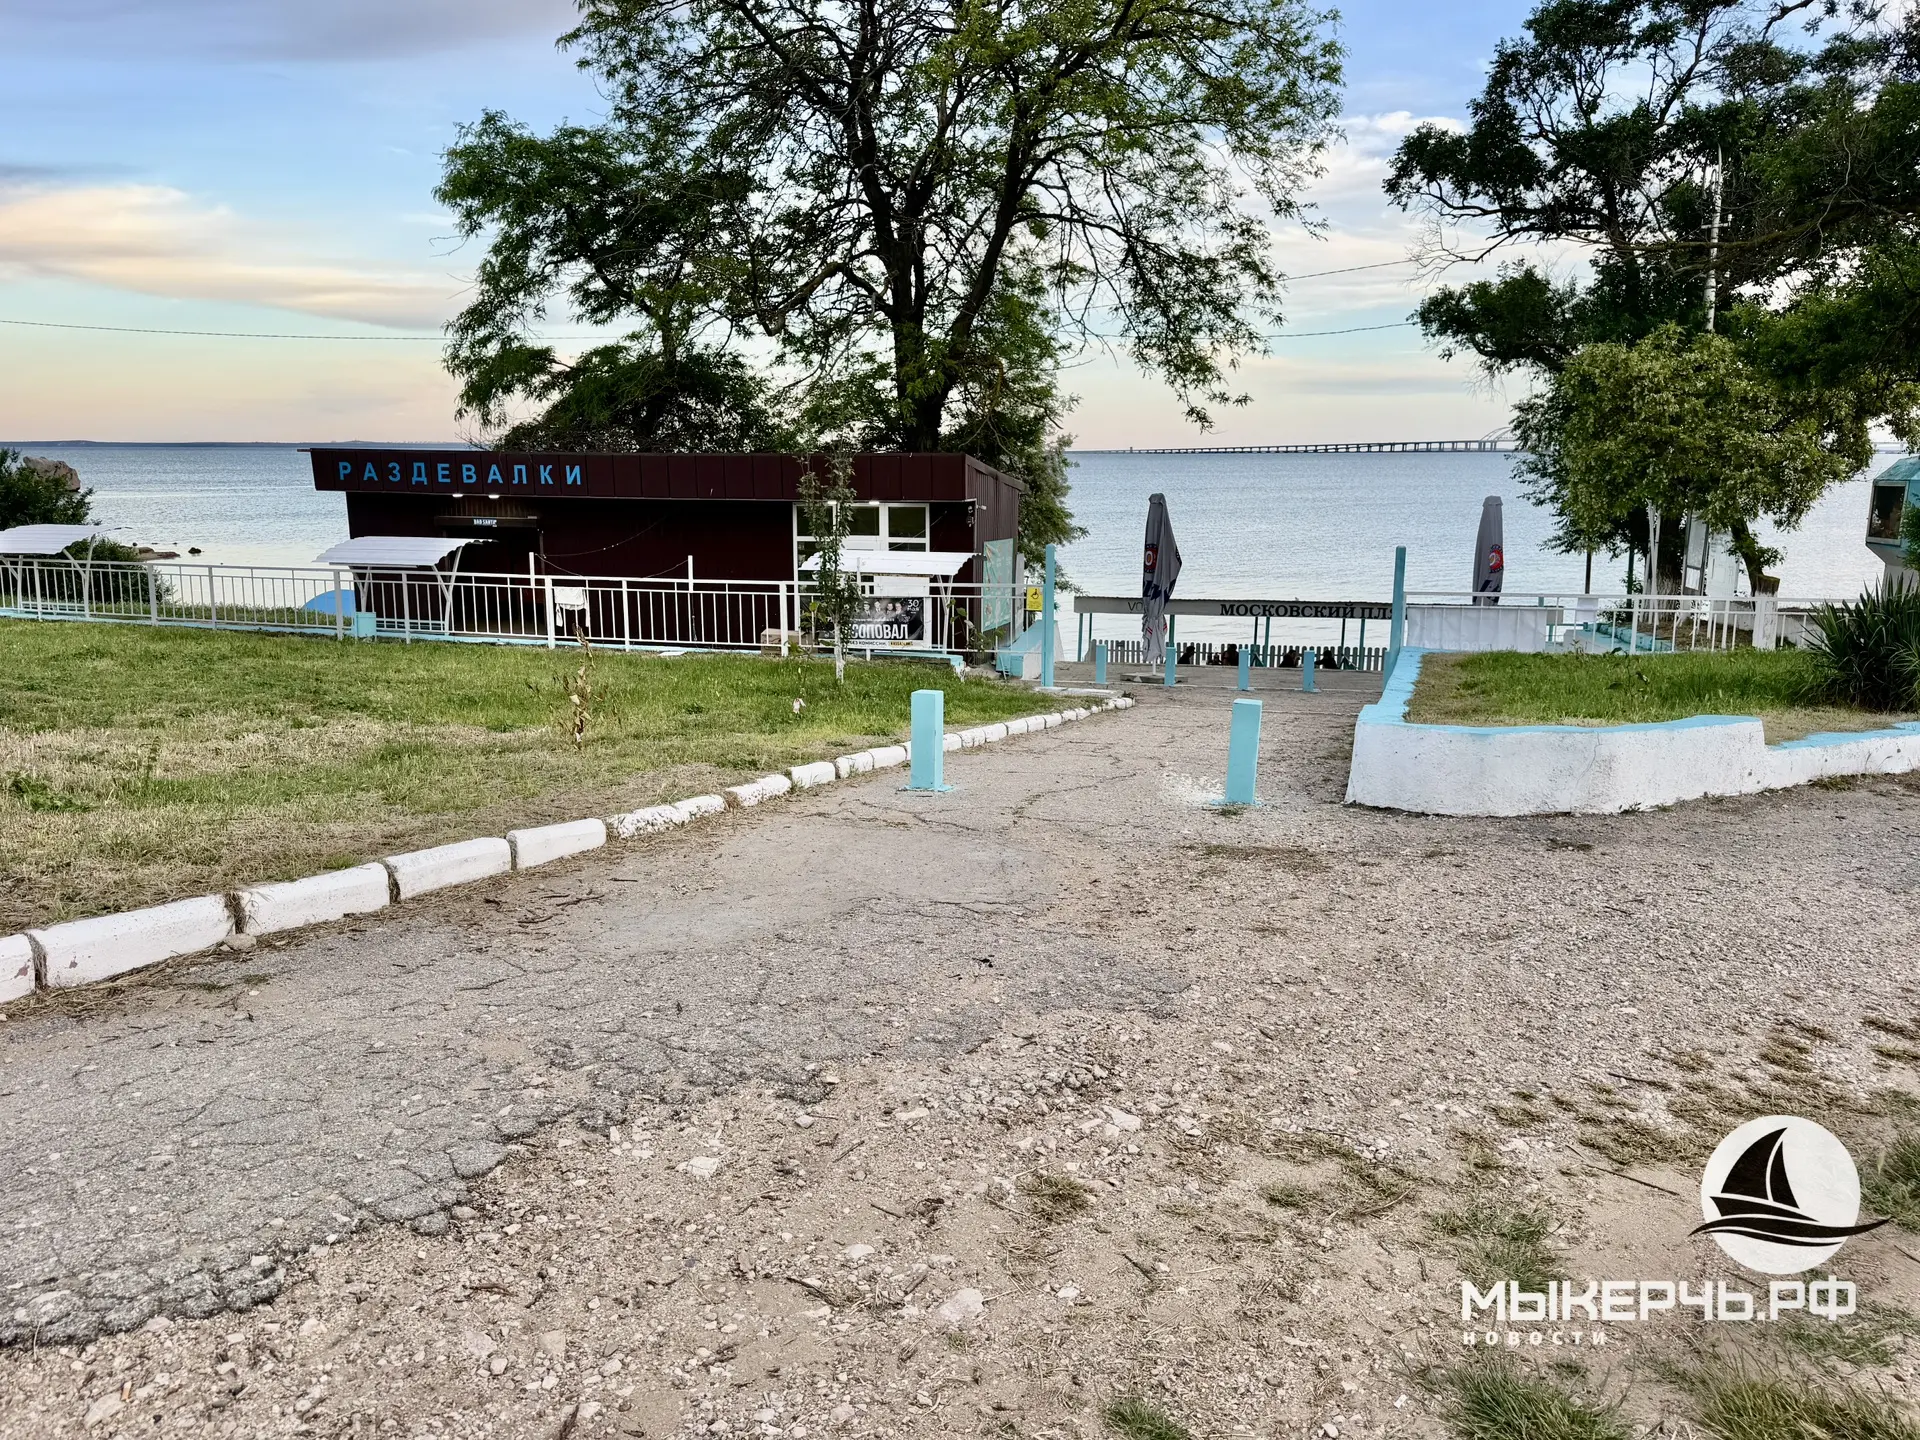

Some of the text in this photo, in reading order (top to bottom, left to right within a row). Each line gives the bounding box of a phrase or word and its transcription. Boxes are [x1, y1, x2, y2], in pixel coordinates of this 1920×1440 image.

[338, 461, 582, 486] РАЗДЕВАЛКИ
[908, 599, 919, 607] 30
[1220, 602, 1356, 619] МОСКОВСКИЙ
[848, 624, 909, 639] СОПОВАЛ
